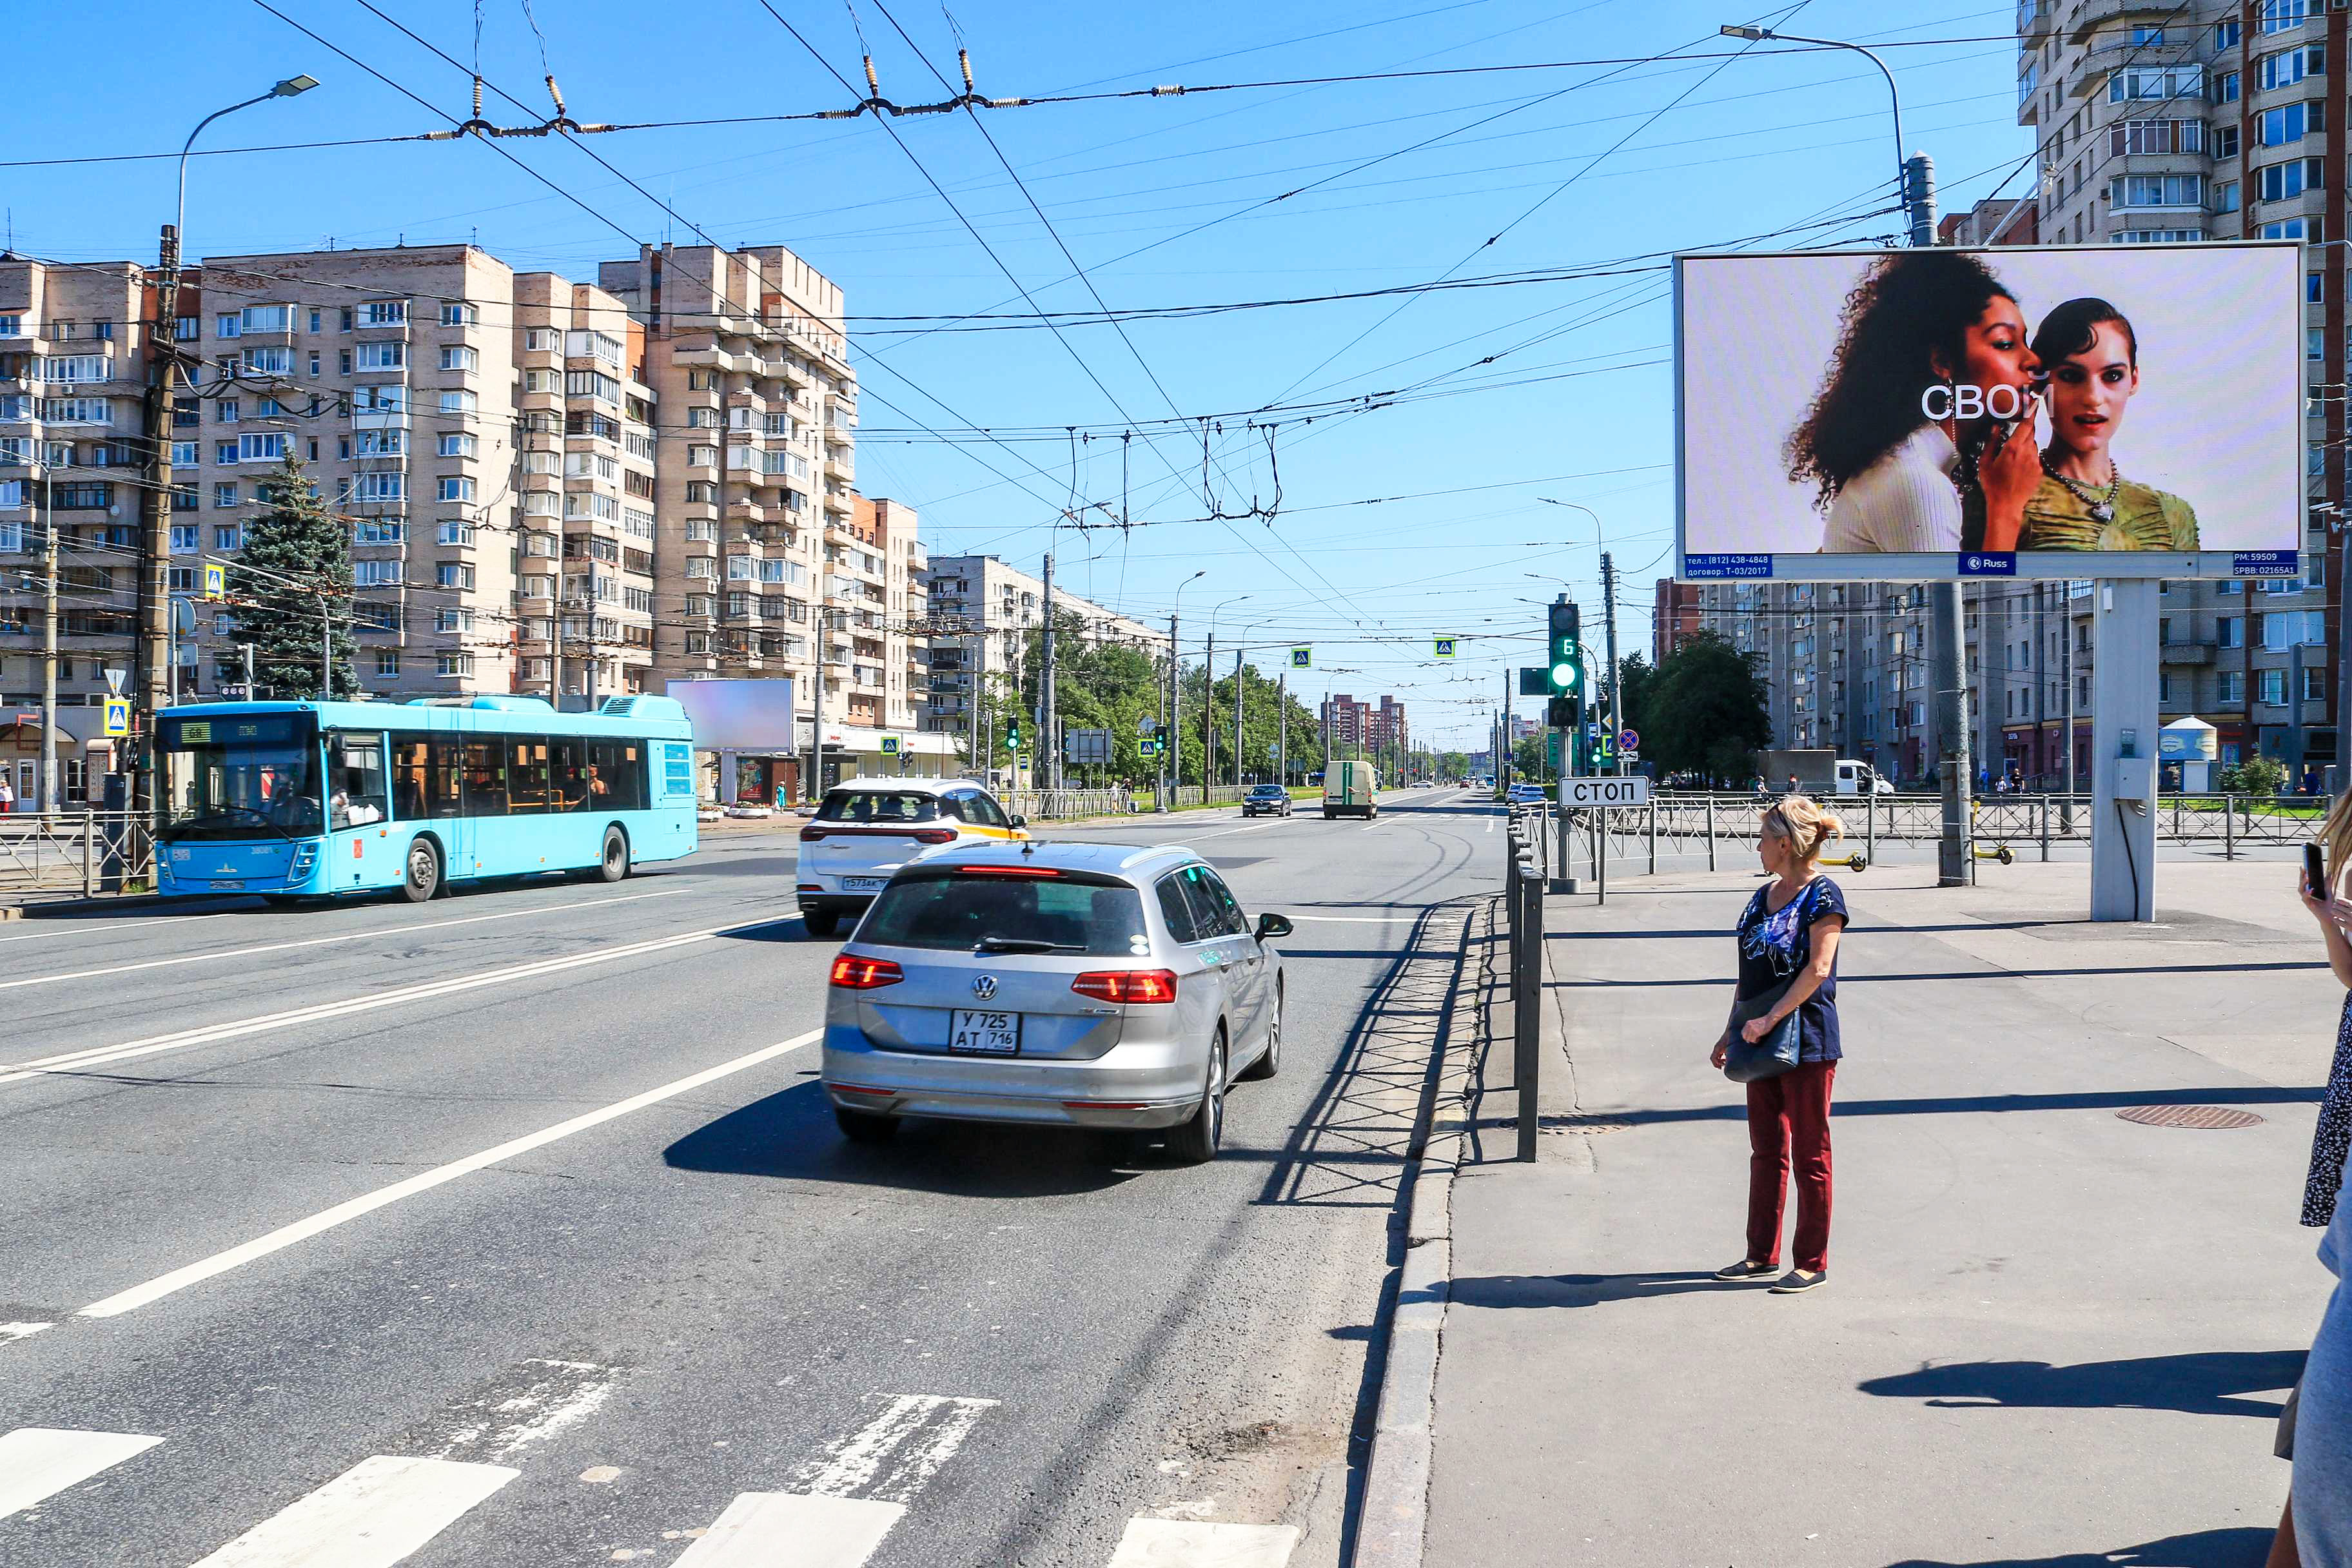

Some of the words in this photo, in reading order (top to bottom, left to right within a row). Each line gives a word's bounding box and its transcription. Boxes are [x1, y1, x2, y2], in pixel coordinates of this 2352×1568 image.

[1709, 556, 1729, 565] (812)
[1731, 556, 1768, 564] 438-4848
[1983, 559, 2007, 567] Russ
[1563, 639, 1574, 655] 6
[1574, 783, 1634, 801] СТОП
[963, 1012, 974, 1026] У
[979, 1013, 1008, 1028] 725
[956, 1032, 980, 1046] АТ
[990, 1032, 1012, 1044] 716
